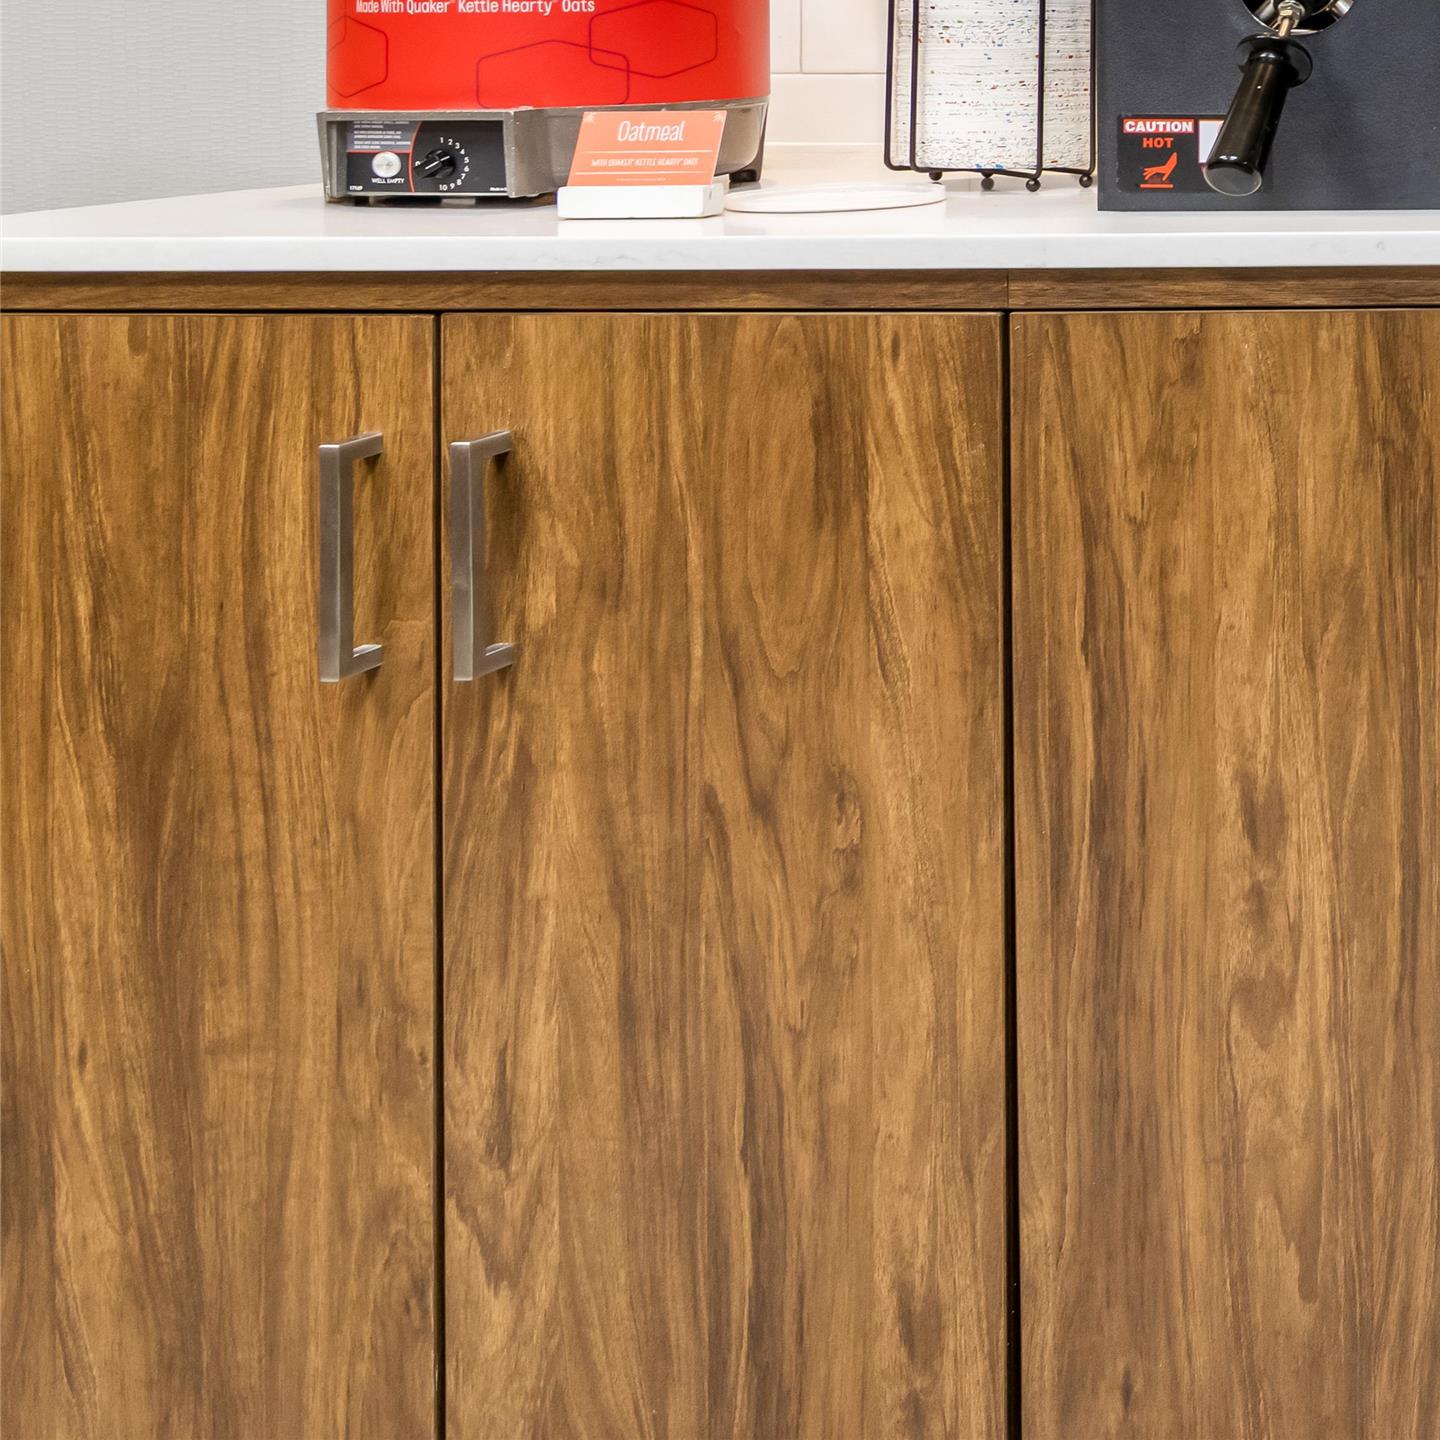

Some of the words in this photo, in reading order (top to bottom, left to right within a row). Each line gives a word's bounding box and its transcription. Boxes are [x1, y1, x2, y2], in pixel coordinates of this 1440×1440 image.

[618, 120, 685, 142] Oatmeal
[1124, 121, 1192, 132] CAUTION
[1142, 137, 1174, 148] HOT
